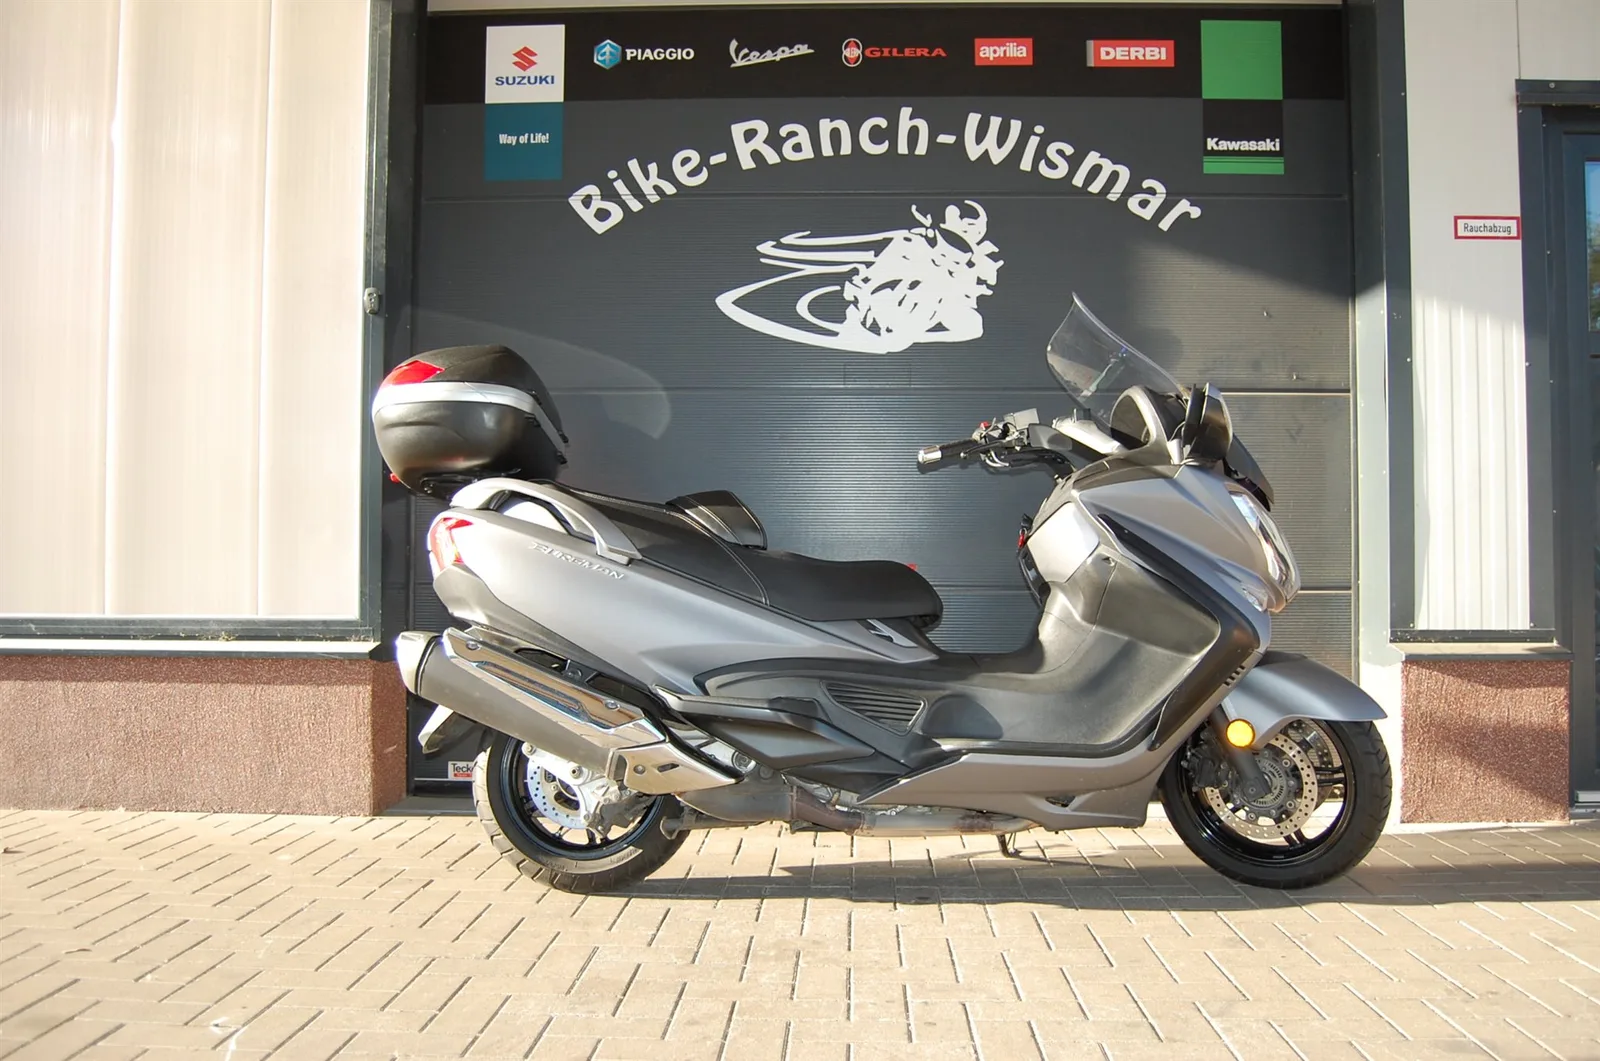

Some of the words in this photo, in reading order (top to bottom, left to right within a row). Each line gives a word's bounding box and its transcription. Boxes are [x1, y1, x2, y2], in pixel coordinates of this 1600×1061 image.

[625, 48, 695, 61] PIAGGIO
[729, 38, 815, 68] Vespa
[864, 47, 947, 58] GILERA
[979, 42, 1028, 61] aprilia
[1100, 47, 1167, 60] DERBI
[495, 75, 555, 86] SUZUKI
[499, 133, 518, 146] Way
[519, 133, 529, 144] of
[530, 132, 550, 144] Life!
[1206, 137, 1281, 151] Kawasaki
[567, 106, 1202, 235] Bike-Ranch-Wismar
[1463, 222, 1512, 235] Rauchabzug
[451, 762, 473, 773] Teck
